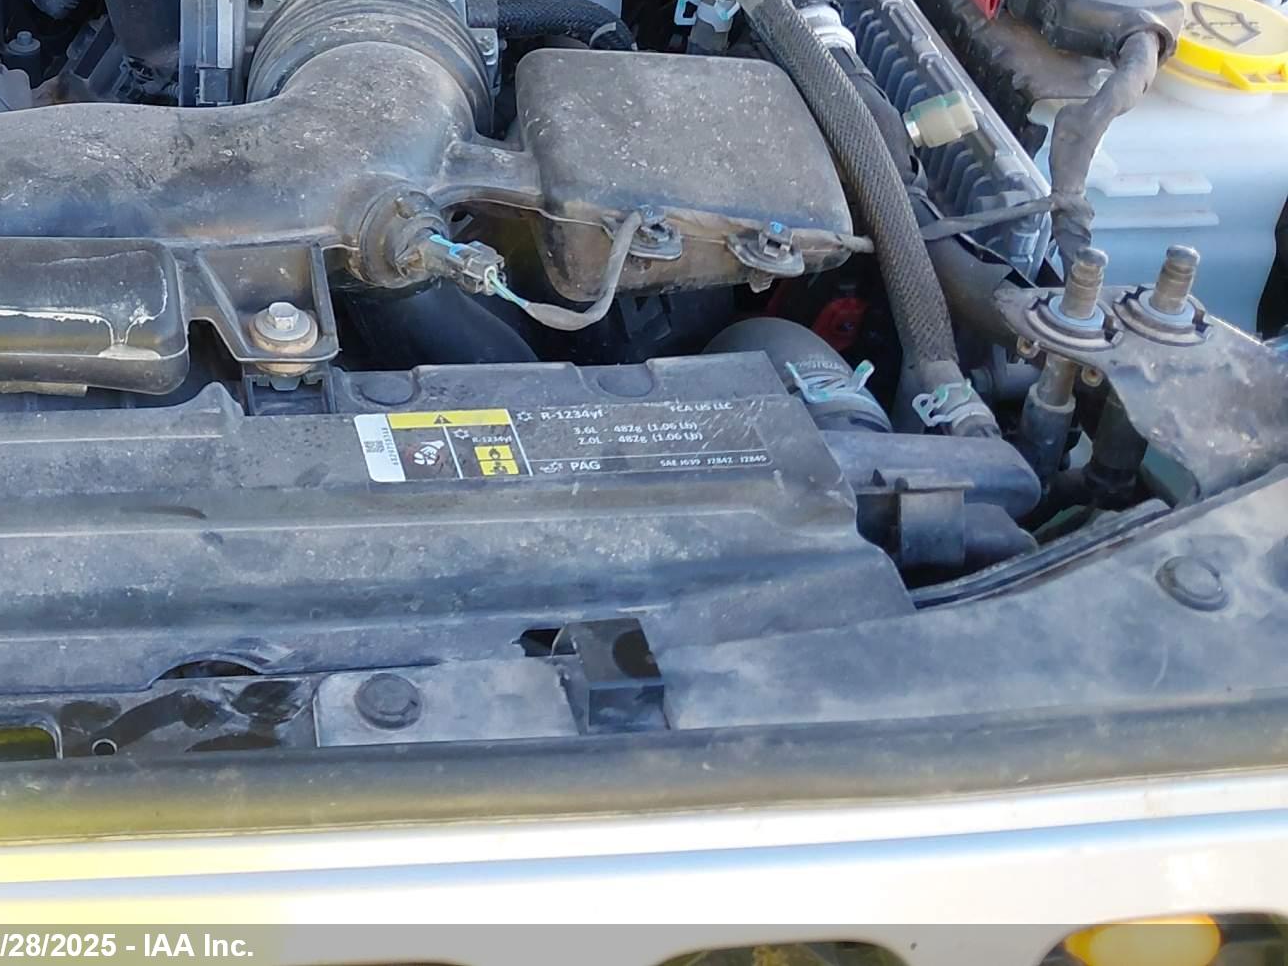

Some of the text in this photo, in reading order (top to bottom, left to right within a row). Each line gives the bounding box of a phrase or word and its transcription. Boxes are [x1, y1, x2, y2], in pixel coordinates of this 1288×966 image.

[695, 403, 712, 411] US
[713, 401, 733, 410] LLC
[540, 410, 604, 420] R-1234yf
[573, 426, 598, 435] 3.6L
[578, 436, 603, 445] 2.0L
[570, 461, 601, 470] PAG
